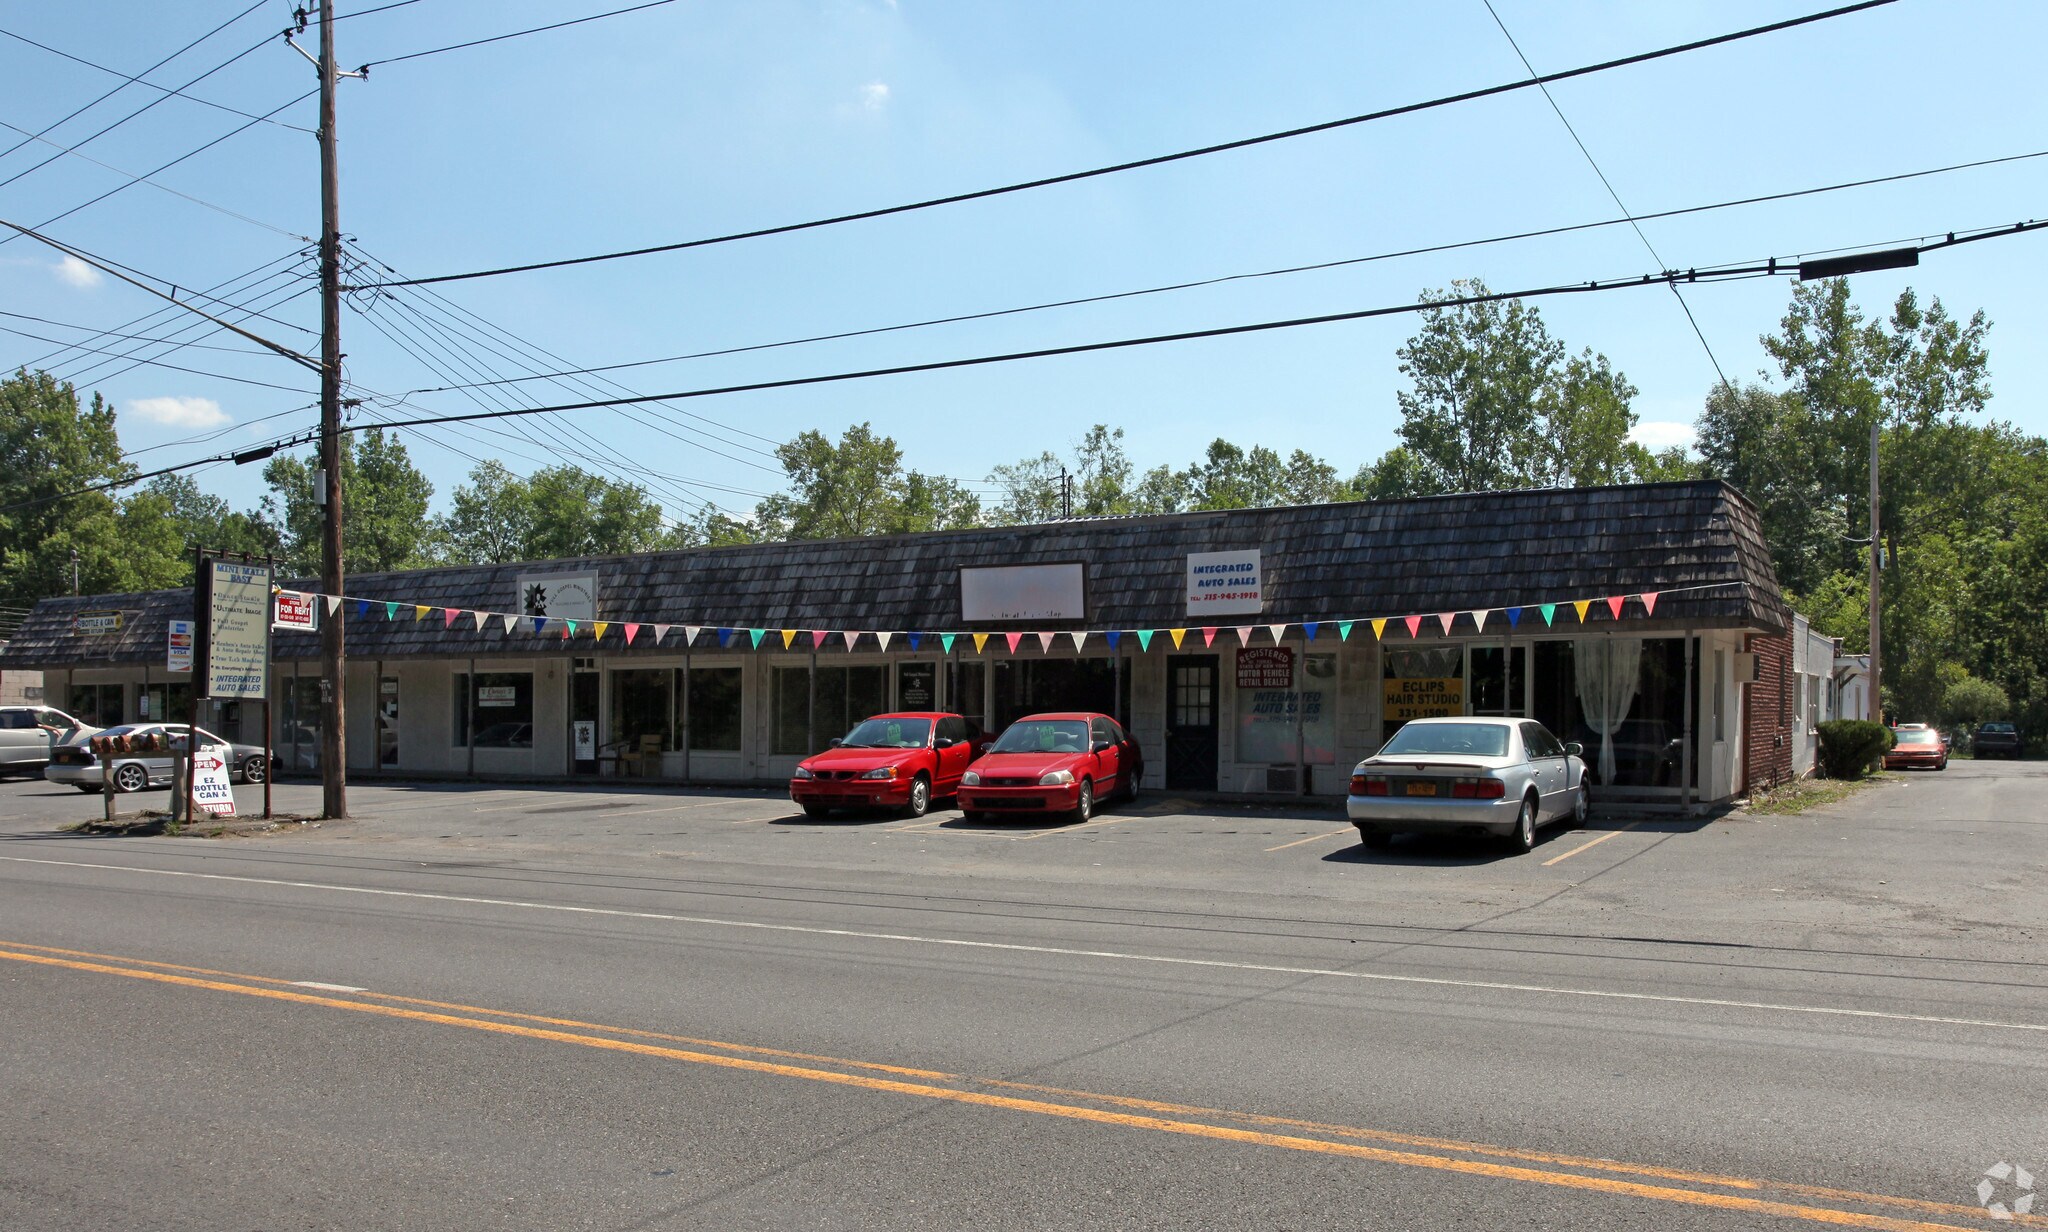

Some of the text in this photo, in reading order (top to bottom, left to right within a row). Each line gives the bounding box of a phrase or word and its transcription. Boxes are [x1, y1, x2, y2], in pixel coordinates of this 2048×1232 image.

[216, 564, 267, 576] MINI MALL
[1193, 563, 1254, 574] INTEGRATED
[230, 575, 252, 584] EAST
[1198, 577, 1257, 588] AUTO SALES
[1204, 592, 1258, 600] 315-945-1918
[280, 604, 310, 616] FOR RENT
[1239, 648, 1289, 664] REGISTERED
[1238, 669, 1290, 678] MOTOR VEHICLE
[215, 675, 262, 683] INTEGRATED
[1239, 678, 1289, 686] RETAIL DEALER
[238, 684, 261, 692] SALES
[1402, 681, 1445, 692] ECLIPS
[1387, 693, 1460, 704] HAIR STUDIO
[1253, 703, 1321, 713] AUTO SAES
[194, 784, 228, 792] BOTTLE
[201, 803, 232, 813] ETURN
